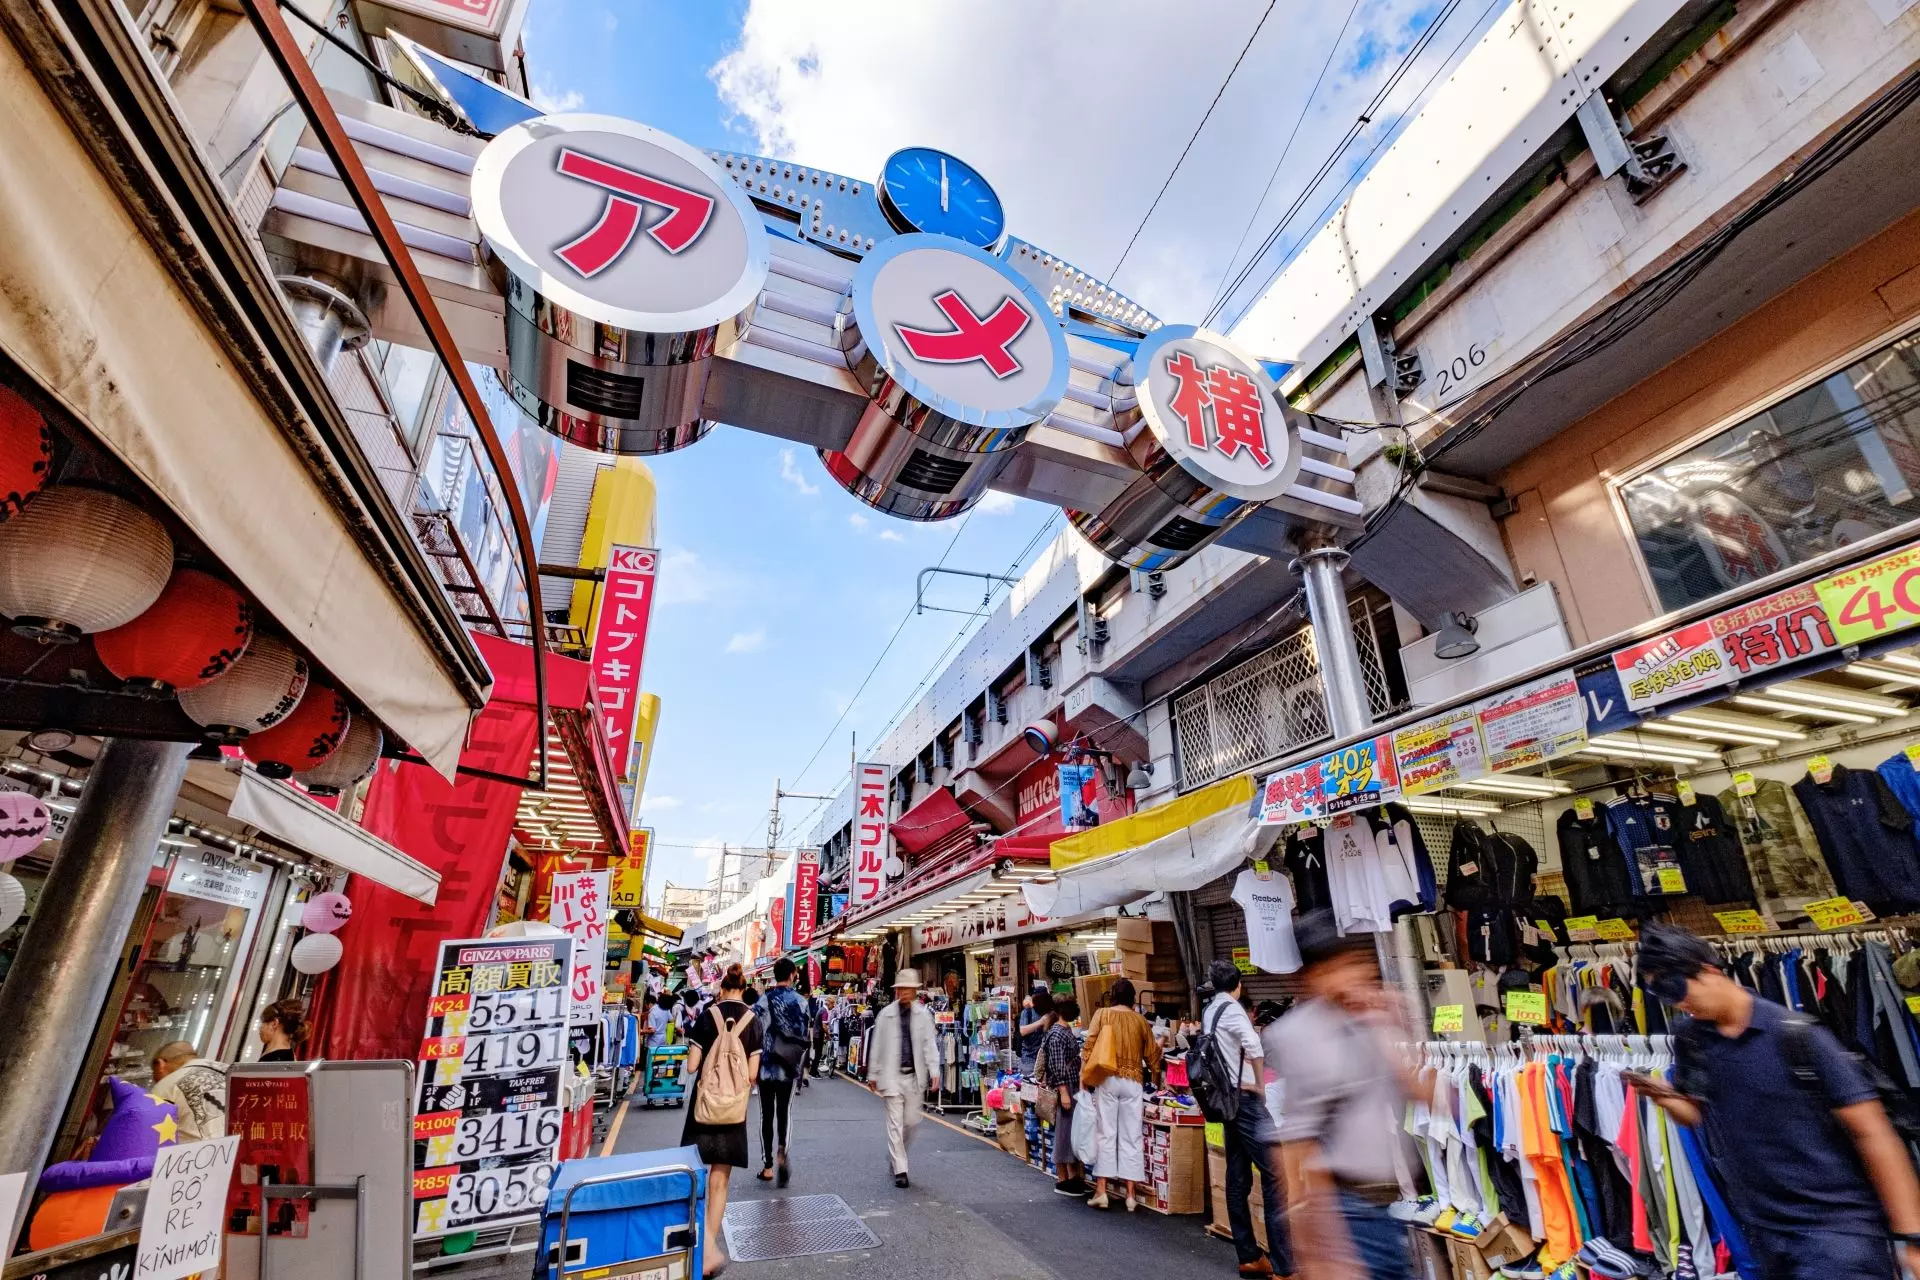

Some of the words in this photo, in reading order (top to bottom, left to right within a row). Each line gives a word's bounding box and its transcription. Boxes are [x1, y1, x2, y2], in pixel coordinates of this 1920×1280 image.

[552, 148, 714, 279] ア
[892, 289, 1031, 380] メ
[1166, 351, 1273, 470] 横
[1437, 344, 1487, 396] 206
[612, 549, 656, 572] KG
[1723, 605, 1837, 673] 特价
[598, 578, 645, 760] コトブキゴル
[1635, 636, 1681, 674] SALE!
[1072, 688, 1085, 710] 207
[1328, 747, 1372, 778] 40%
[1336, 767, 1373, 798] オフ
[858, 769, 886, 900] 二木ゴルフ
[801, 852, 816, 860] KG
[1252, 894, 1282, 903] Reebok
[463, 949, 502, 962] GINZA
[515, 947, 550, 959] PARIS
[440, 960, 561, 996] 高額買取
[434, 1000, 464, 1012] K24
[470, 989, 566, 1028] 5511
[427, 1043, 458, 1056] K18
[464, 1028, 565, 1073] 4191
[426, 1087, 438, 1095] 2F
[509, 1077, 546, 1087] TAX-FREE
[237, 1094, 298, 1109] ブランド品
[231, 1121, 306, 1141] 高価買取
[414, 1116, 460, 1130] Pt1000
[457, 1108, 560, 1157] 3416
[451, 1164, 555, 1215] 3058
